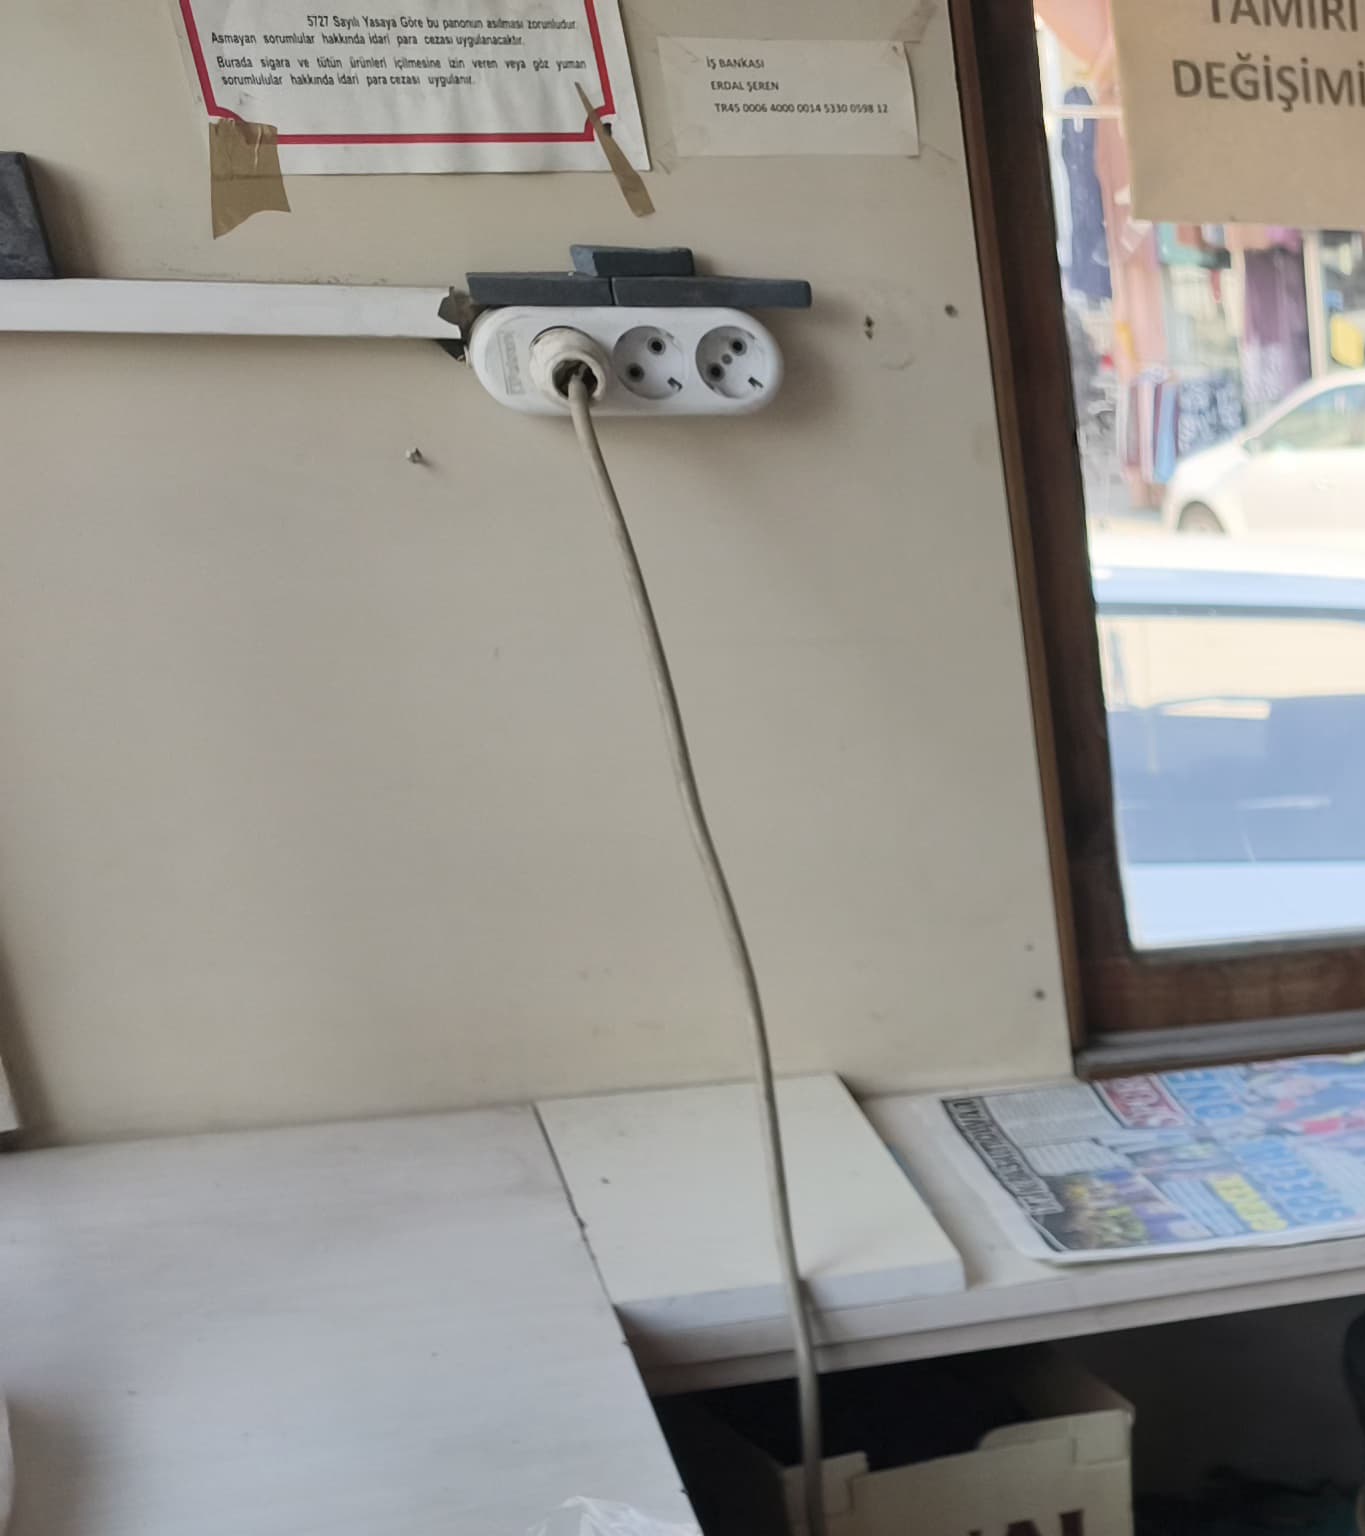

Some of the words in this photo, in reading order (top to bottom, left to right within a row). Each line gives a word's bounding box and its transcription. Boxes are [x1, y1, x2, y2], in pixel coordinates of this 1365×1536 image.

[306, 15, 329, 28] 5727
[333, 16, 360, 31] Sayılı
[362, 16, 397, 30] Yasaya
[400, 16, 424, 29] Göre
[427, 16, 439, 28] bu
[443, 18, 483, 31] panonun
[211, 32, 257, 46] Asmayan
[263, 32, 315, 45] sorumlular
[322, 32, 365, 45] hakkında
[369, 33, 390, 45] idari
[397, 34, 418, 47] para
[424, 34, 452, 45] cezası
[216, 56, 253, 69] Burada
[260, 57, 290, 71] sigara
[297, 58, 309, 69] ve
[317, 57, 342, 69] tütün
[350, 57, 387, 69] ürünleri
[394, 57, 441, 71] içilmesine
[449, 57, 465, 69] izin
[472, 59, 498, 69] veren
[504, 59, 526, 72] veya
[533, 58, 550, 71] göz
[555, 60, 587, 73] yuman
[718, 57, 765, 69] BANKASI
[291, 74, 335, 86] hakkında
[337, 74, 359, 86] idari
[366, 75, 388, 88] para
[390, 75, 420, 86] cezası
[710, 80, 744, 91] ERDAL
[746, 80, 780, 93] ŞEREN
[714, 102, 740, 113] TR45
[742, 103, 768, 113] 0006
[770, 103, 795, 113] 4000
[796, 103, 821, 113] 0014
[876, 104, 889, 114] 12
